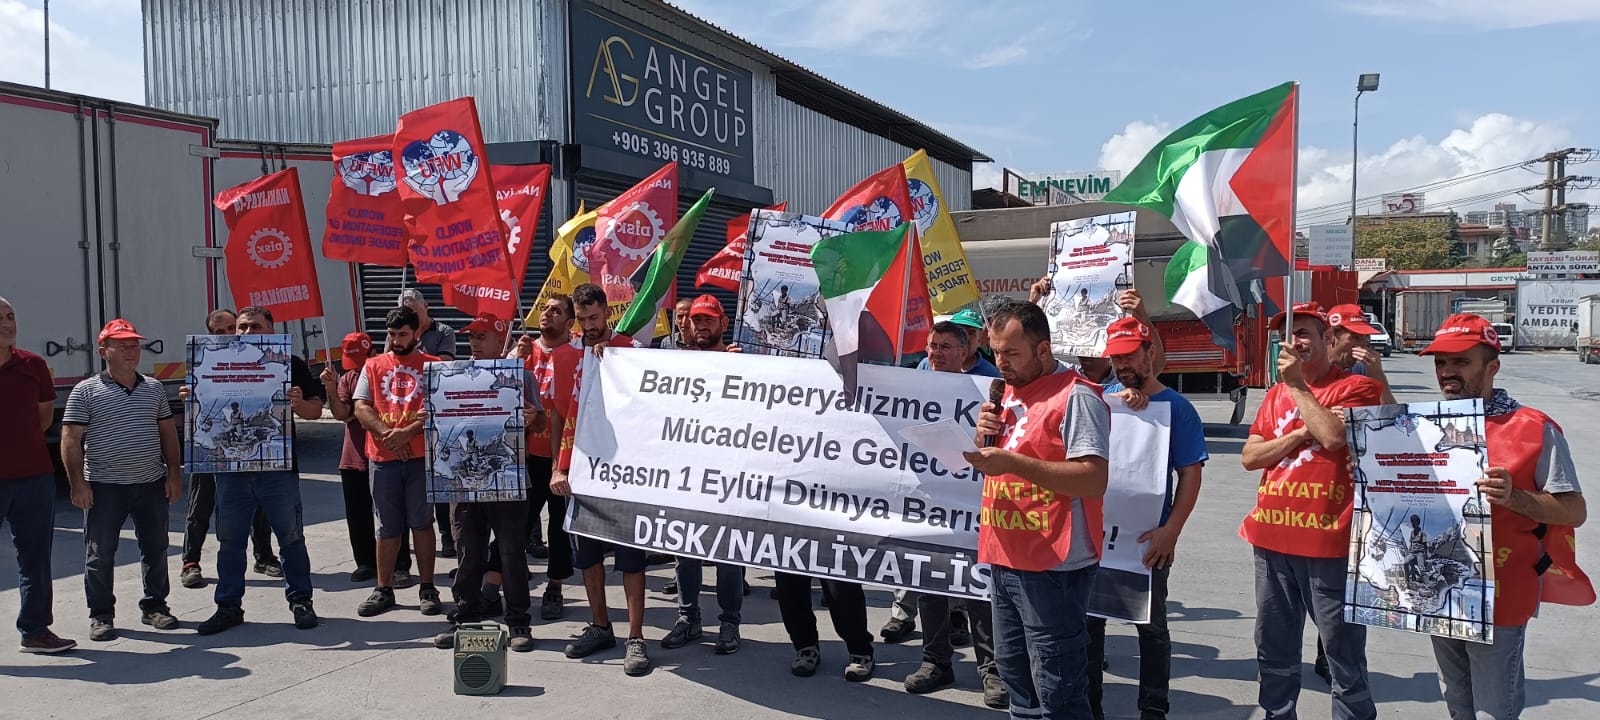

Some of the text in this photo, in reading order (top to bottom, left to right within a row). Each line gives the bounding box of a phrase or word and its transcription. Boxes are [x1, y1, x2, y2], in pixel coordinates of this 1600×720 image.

[644, 46, 745, 114] ANGEL
[644, 87, 746, 147] GROUP
[612, 131, 730, 175] +905 396 935 889
[639, 369, 712, 403] Barış,
[721, 374, 942, 423] Emperyalizme
[661, 416, 842, 463] Mücadeleyle
[588, 456, 670, 489] Yaşasın
[677, 466, 692, 492] 1
[700, 469, 774, 503] Eylül
[783, 479, 890, 522] Dünya
